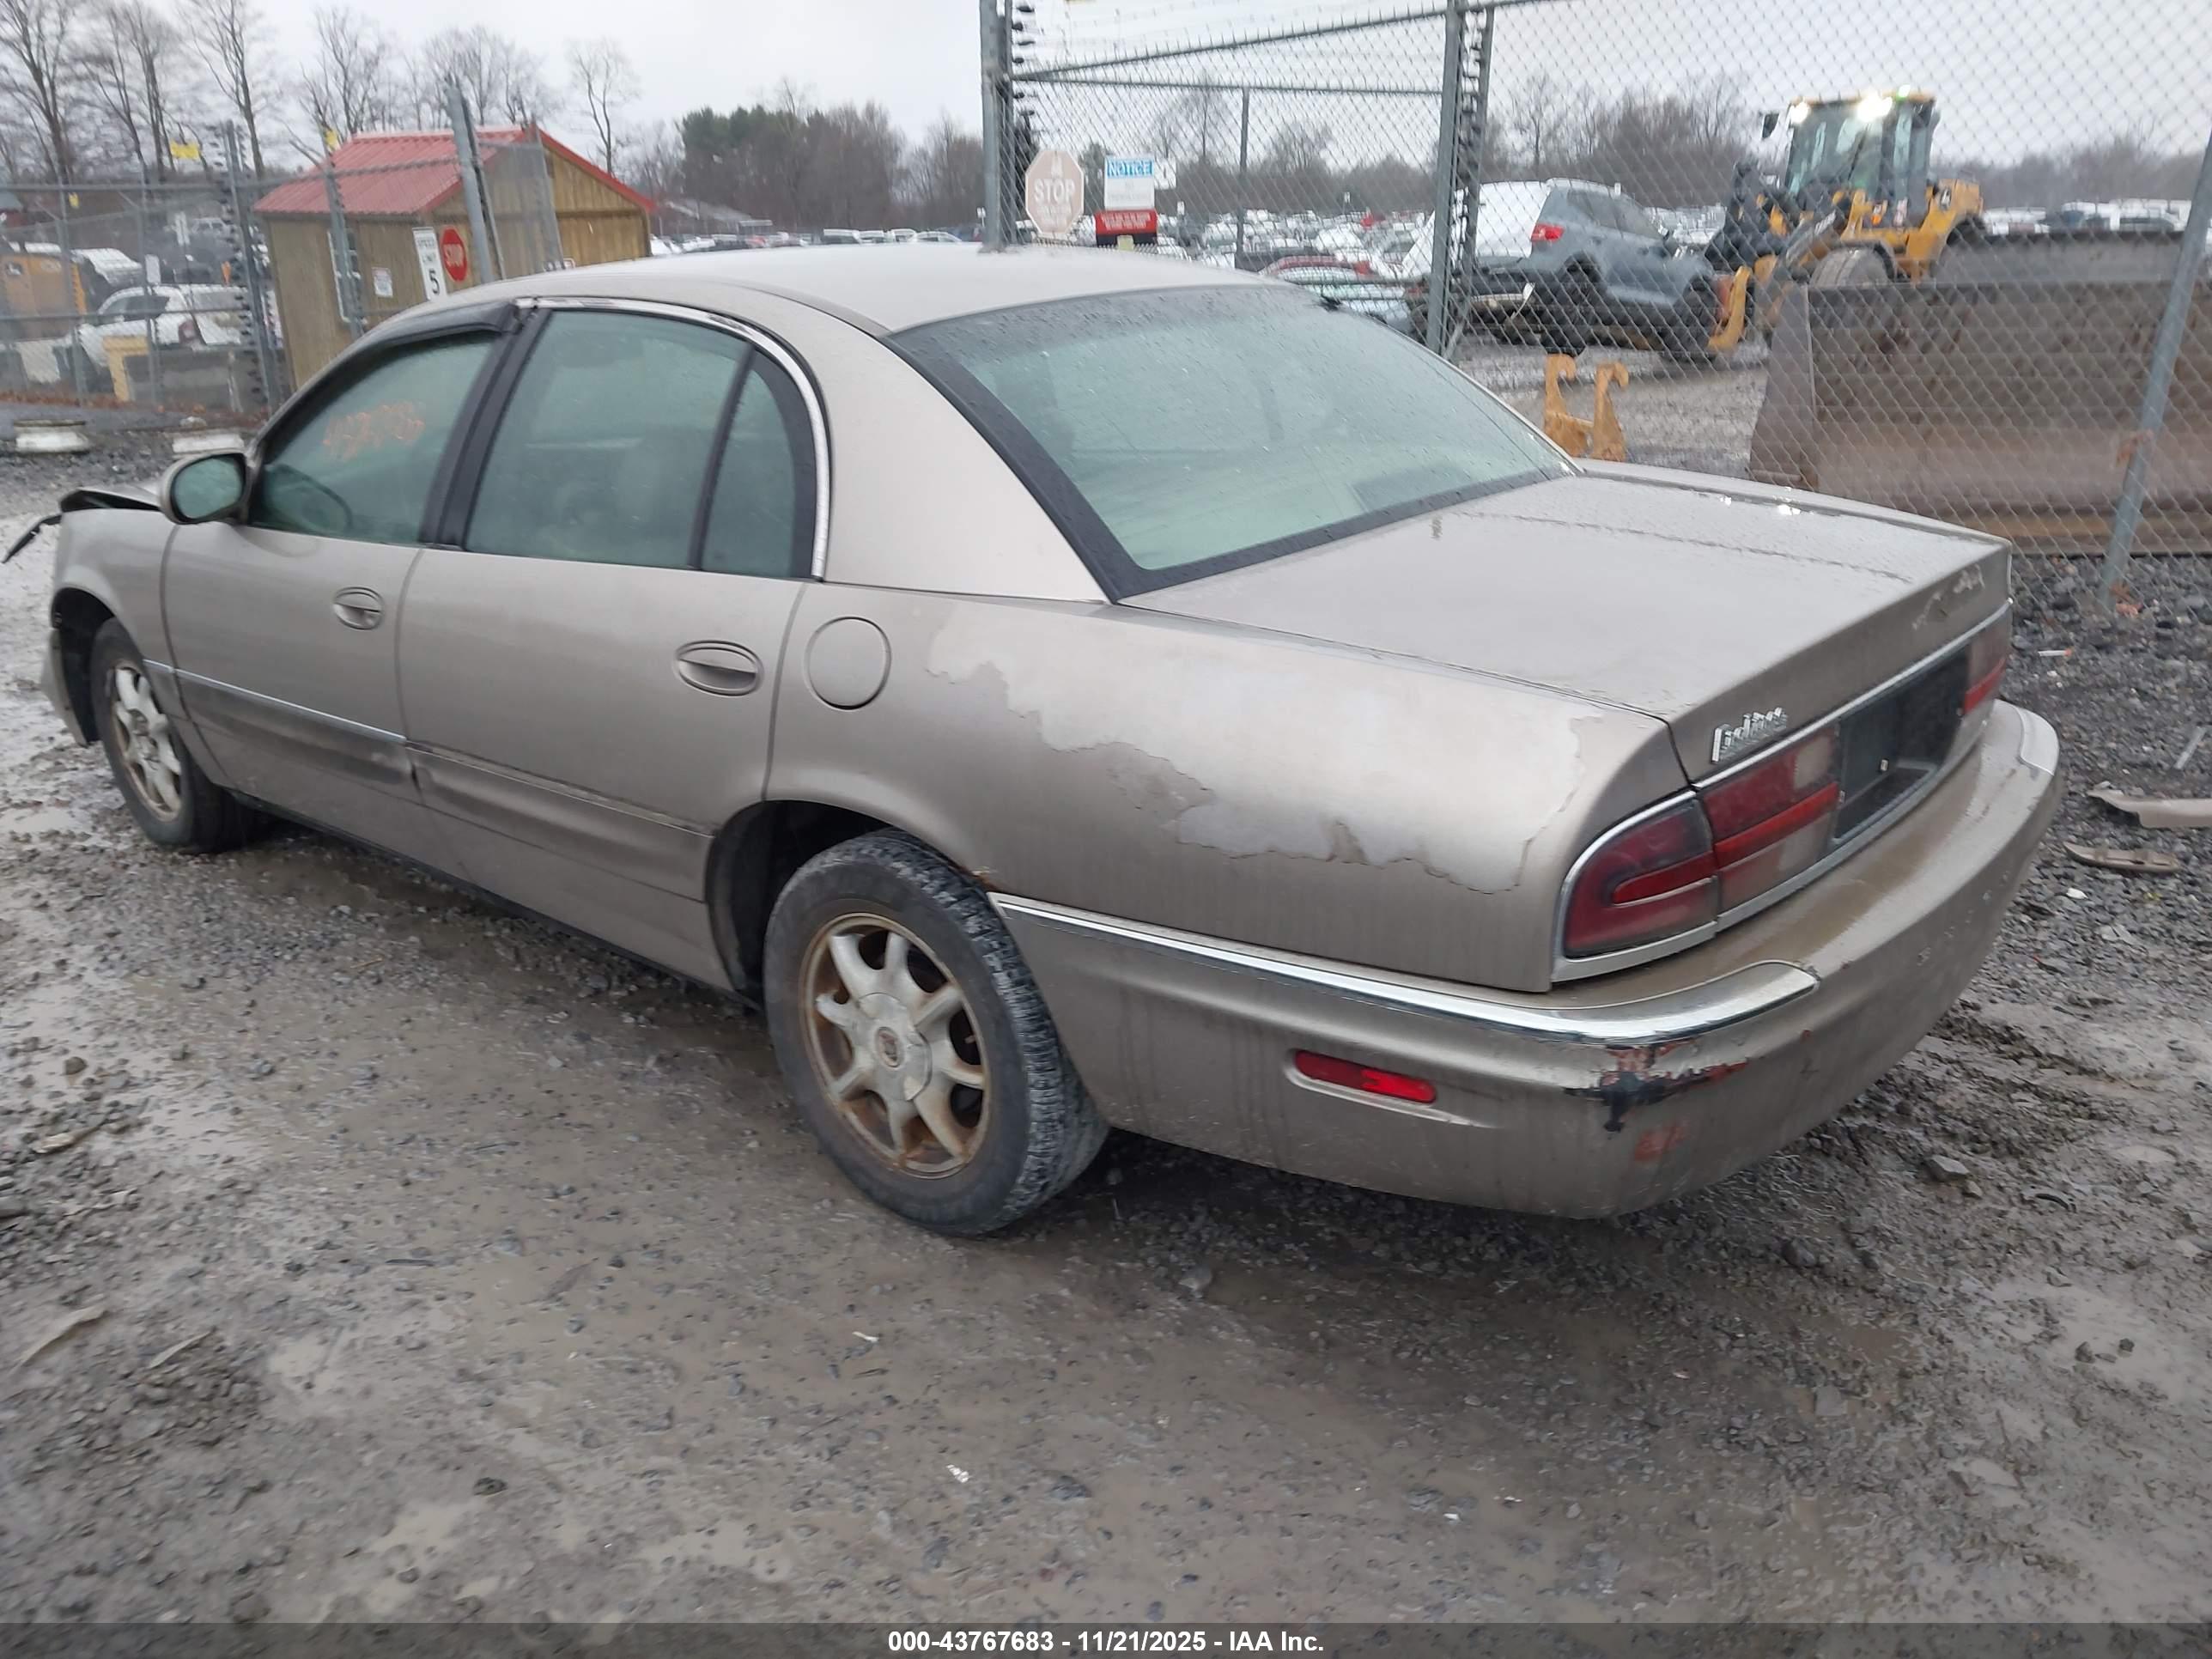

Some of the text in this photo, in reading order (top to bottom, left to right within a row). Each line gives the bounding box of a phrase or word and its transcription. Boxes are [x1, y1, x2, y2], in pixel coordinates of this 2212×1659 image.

[1107, 160, 1152, 176] NOTICE
[1033, 178, 1075, 205] STOP
[443, 243, 464, 267] STOP
[428, 268, 440, 295] 5
